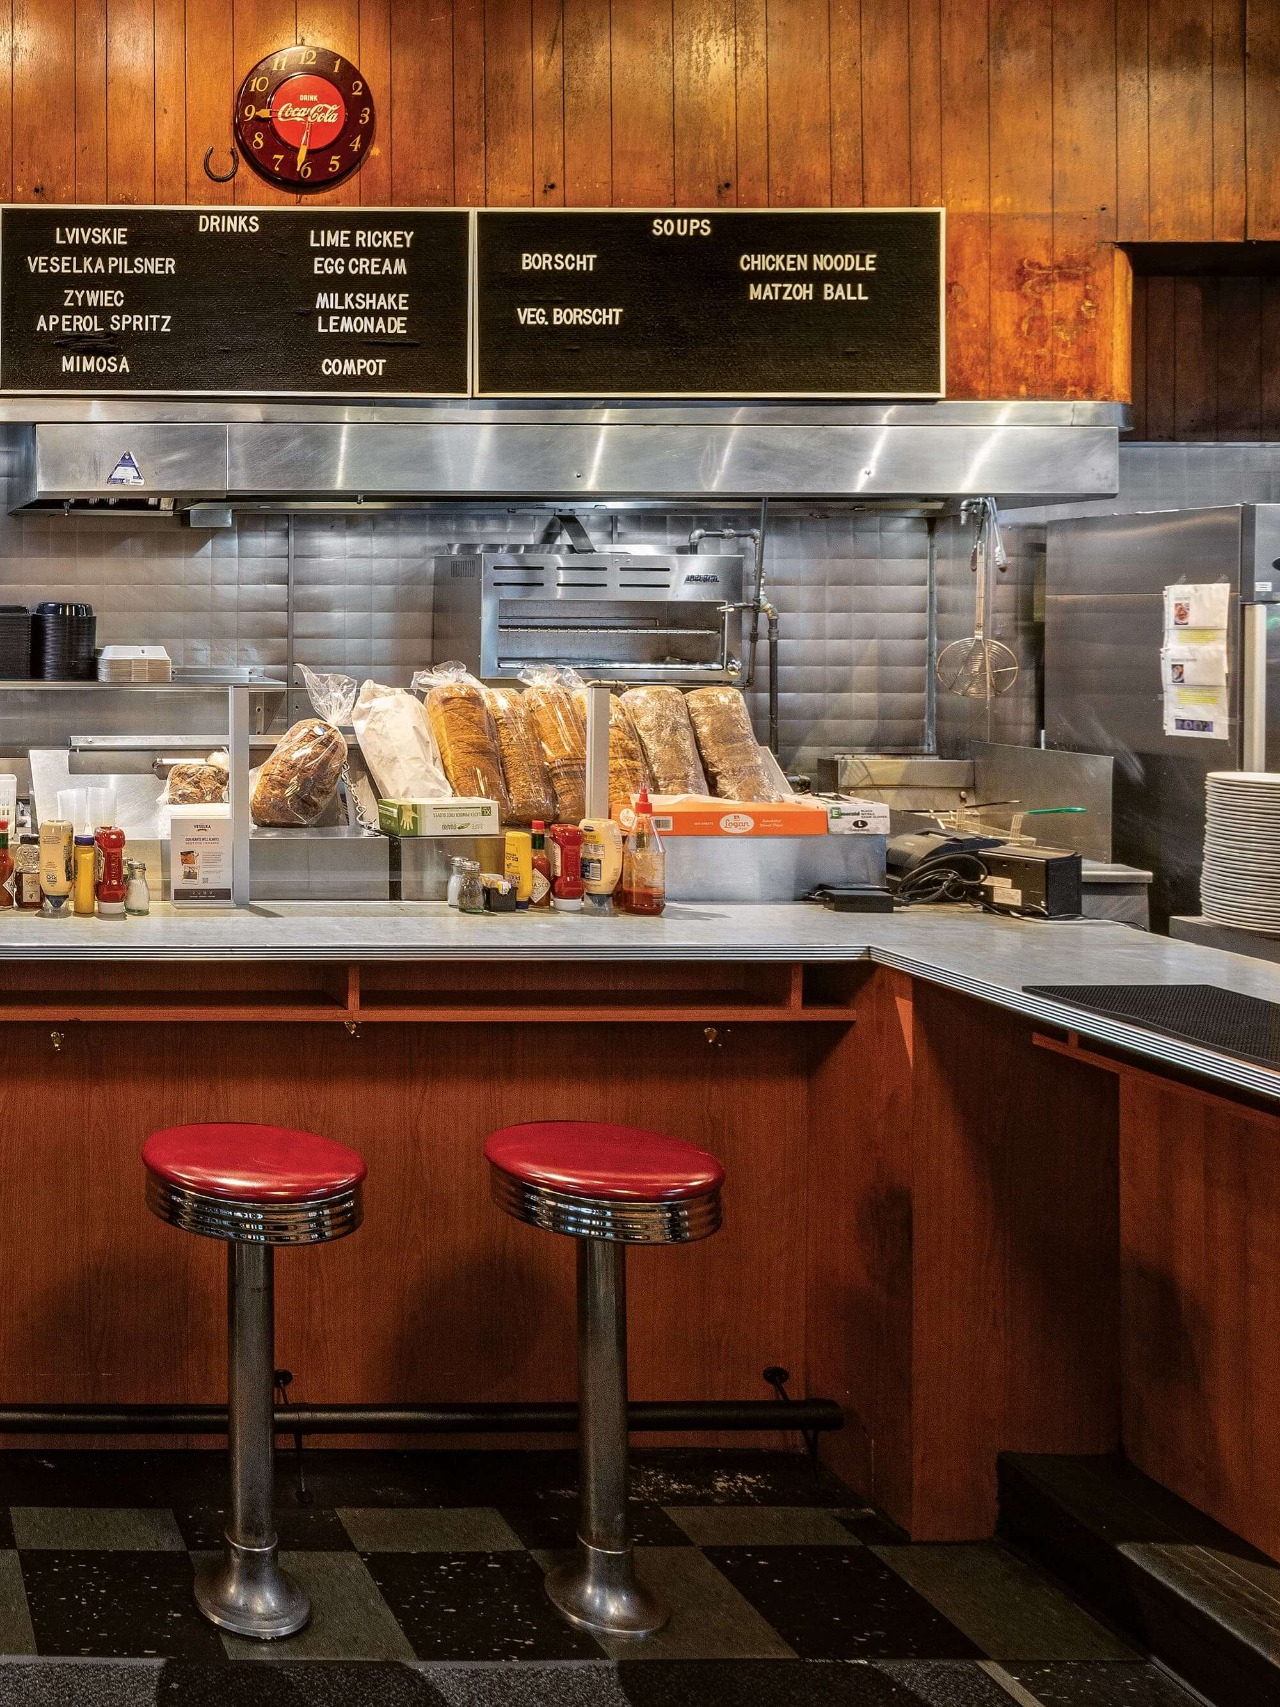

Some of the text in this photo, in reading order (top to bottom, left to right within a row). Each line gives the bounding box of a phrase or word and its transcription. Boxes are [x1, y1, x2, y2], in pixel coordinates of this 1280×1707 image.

[272, 53, 287, 71] 11
[299, 50, 317, 65] 12
[333, 58, 341, 73] 1
[249, 77, 269, 92] 10
[352, 81, 363, 95] 2
[244, 105, 256, 121] 9
[359, 108, 370, 124] 3
[252, 132, 264, 149] 8
[349, 135, 361, 151] 4
[273, 155, 285, 171] 7
[300, 162, 312, 178] 6
[329, 155, 341, 172] 5
[199, 215, 259, 232] DRINKS
[653, 219, 710, 235] SOUPS
[56, 228, 127, 244] LVIVSKIE
[310, 230, 414, 247] LIME RICKEY
[28, 256, 175, 274] VESELKA PILSNER
[314, 258, 407, 274] EGG CREAM
[522, 253, 597, 271] BORSCHT
[740, 255, 876, 271] CHICKEN NOODLE
[64, 290, 124, 306] ZYWIEC
[750, 284, 868, 300] MATZOH BALL
[316, 293, 409, 310] MILKSHAKE
[37, 315, 171, 331] APEROL SPRITZ
[318, 316, 407, 333] LEMONADE
[517, 308, 623, 325] VEG. BORSCHT
[62, 355, 129, 372] MIMOSA
[322, 359, 386, 375] COMPOT
[724, 819, 751, 829] Logan
